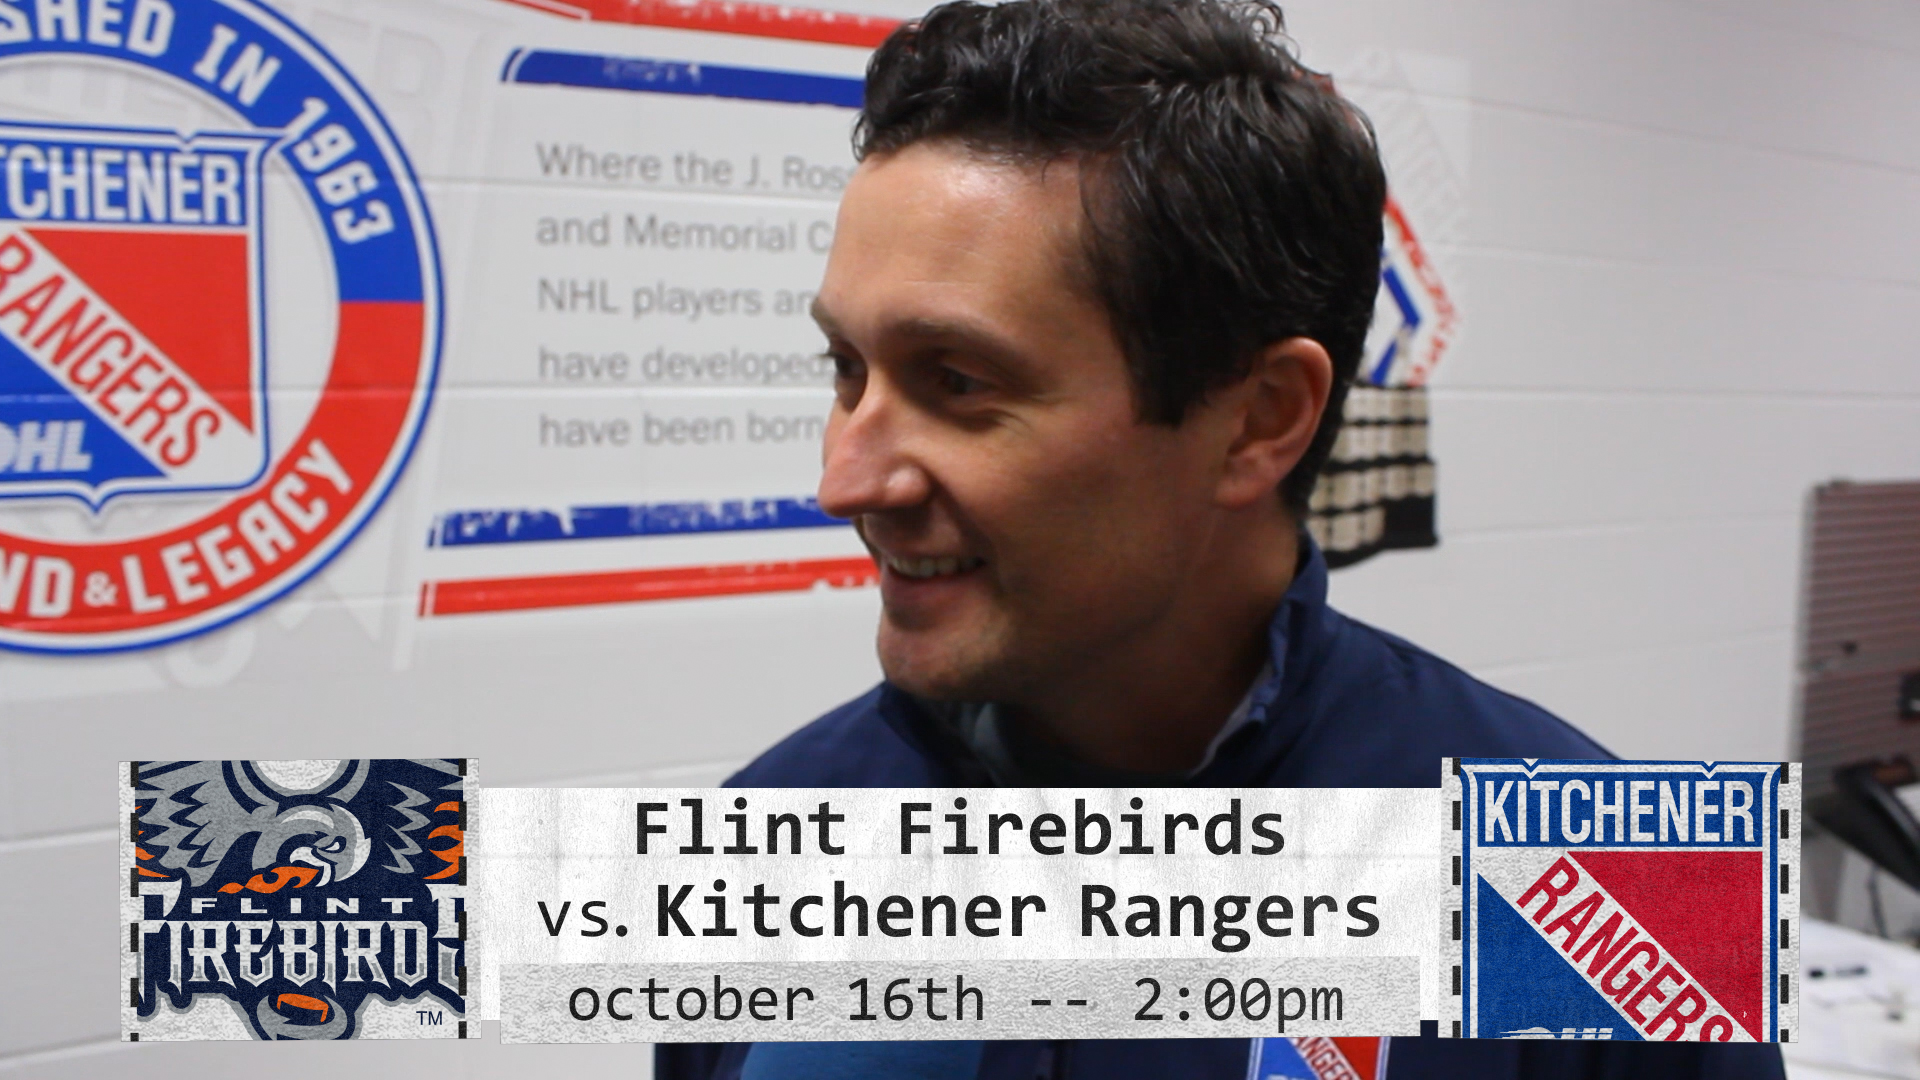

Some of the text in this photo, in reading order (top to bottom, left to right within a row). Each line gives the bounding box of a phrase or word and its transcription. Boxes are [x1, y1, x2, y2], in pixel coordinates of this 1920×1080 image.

[192, 23, 282, 107] IN
[286, 97, 395, 244] 1963
[0, 145, 242, 225] CHENER
[536, 142, 857, 192] Where the J. Ros
[536, 213, 836, 254] and Memorial C
[537, 278, 619, 314] NHL
[633, 282, 762, 322] players
[538, 345, 828, 386] have developed
[539, 413, 630, 447] have
[643, 411, 734, 447] been
[121, 438, 354, 614] LEGACY
